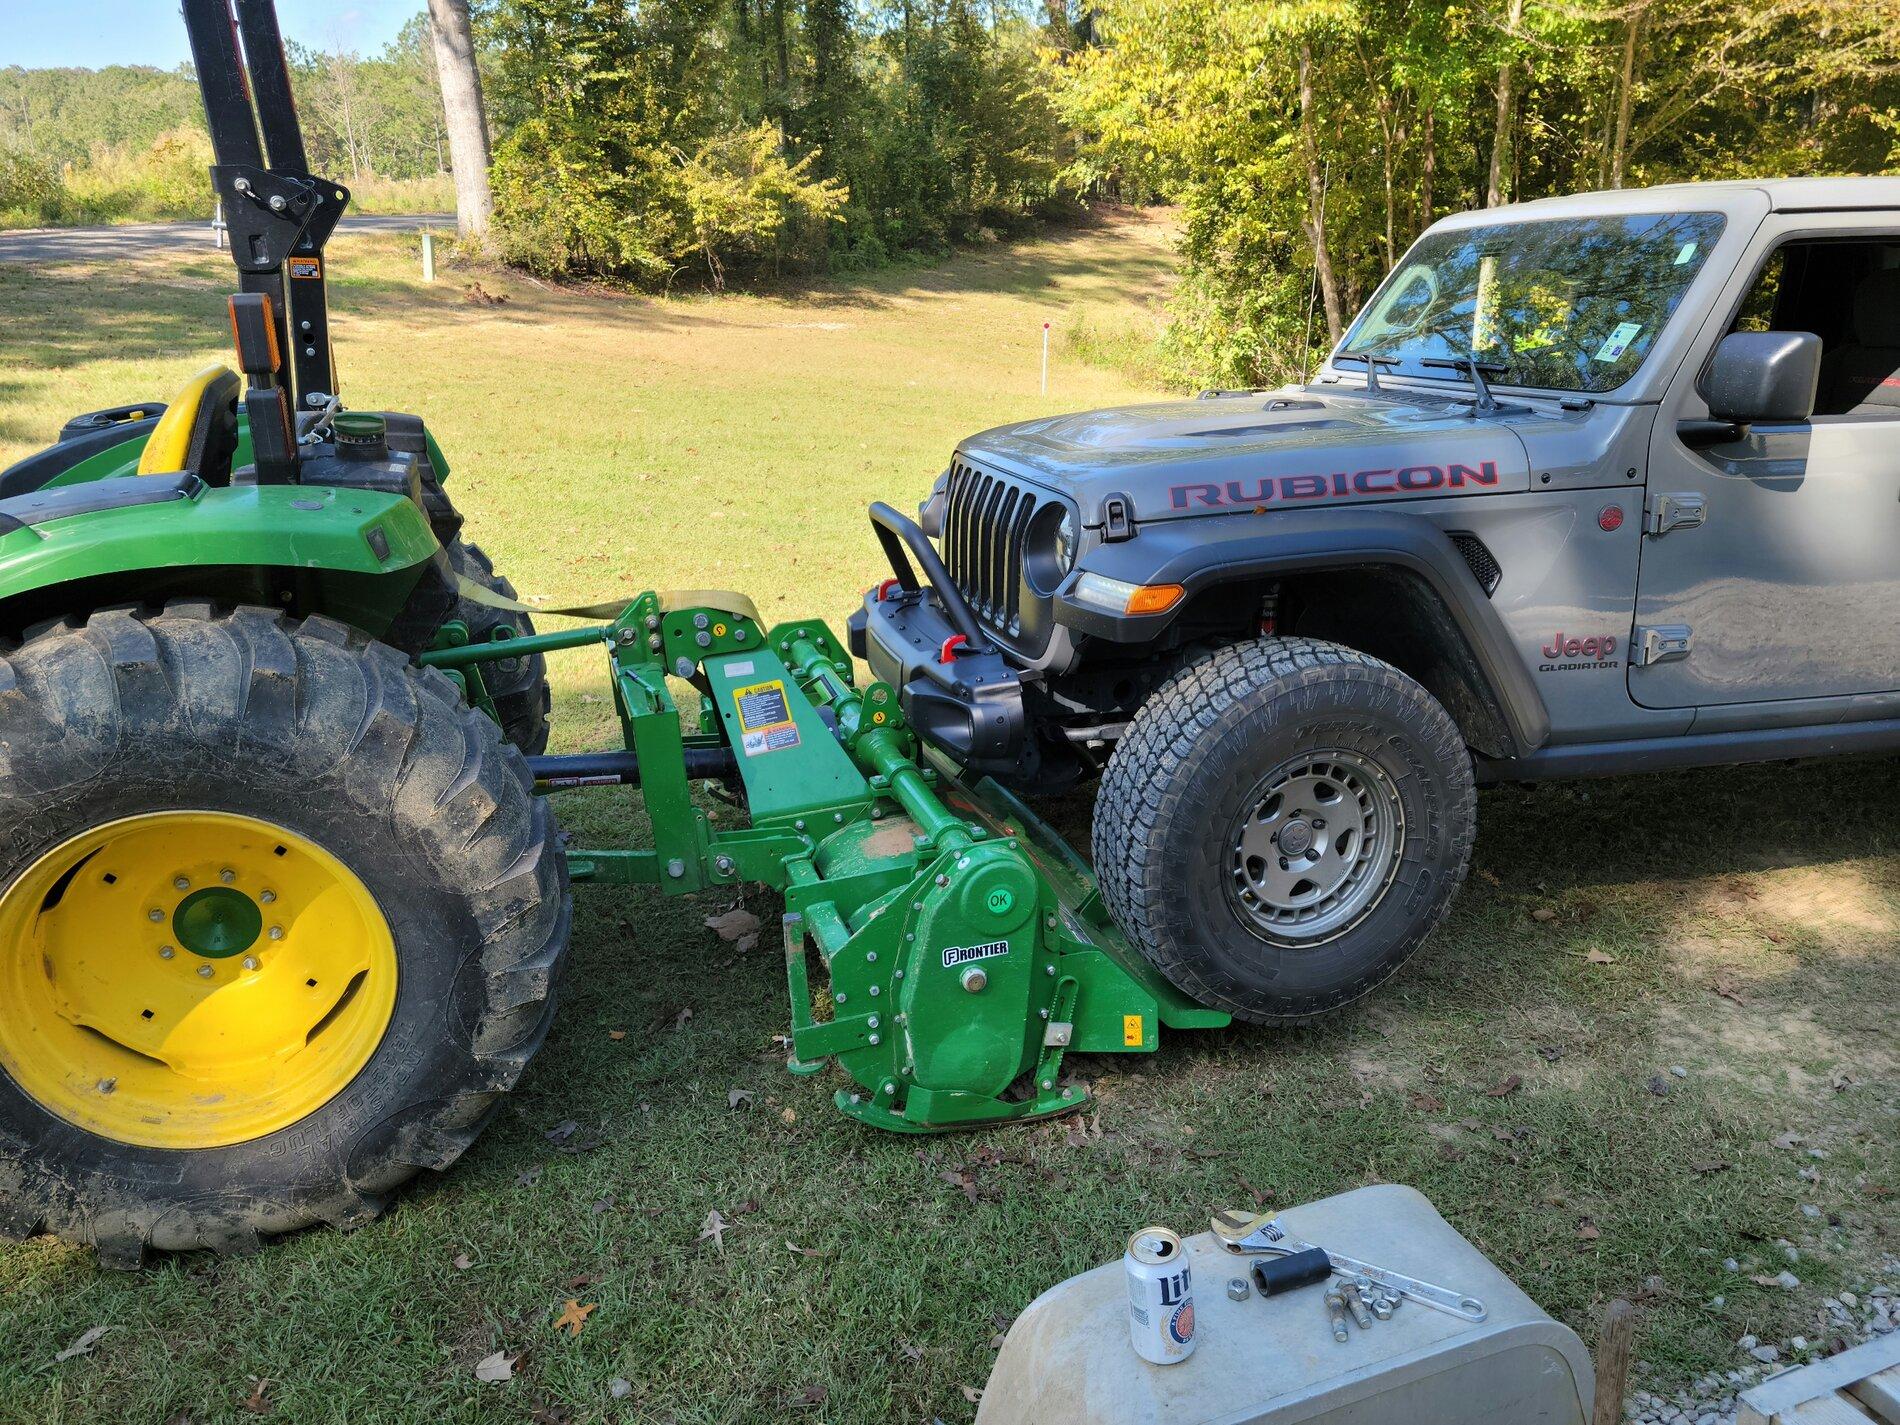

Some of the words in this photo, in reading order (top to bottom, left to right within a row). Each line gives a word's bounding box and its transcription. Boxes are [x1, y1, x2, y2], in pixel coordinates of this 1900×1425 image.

[1169, 461, 1500, 509] RUBICON
[1543, 632, 1617, 661] Jeep
[1539, 661, 1618, 673] GLADIATOR
[753, 685, 774, 693] CAUTION
[991, 893, 1008, 907] OK
[944, 942, 1008, 965] FRONTIER
[333, 1021, 417, 1123] TRACTOR
[296, 1044, 425, 1160] INDUSTRIAL
[270, 1122, 322, 1157] LUG
[1157, 1266, 1192, 1306] Lit
